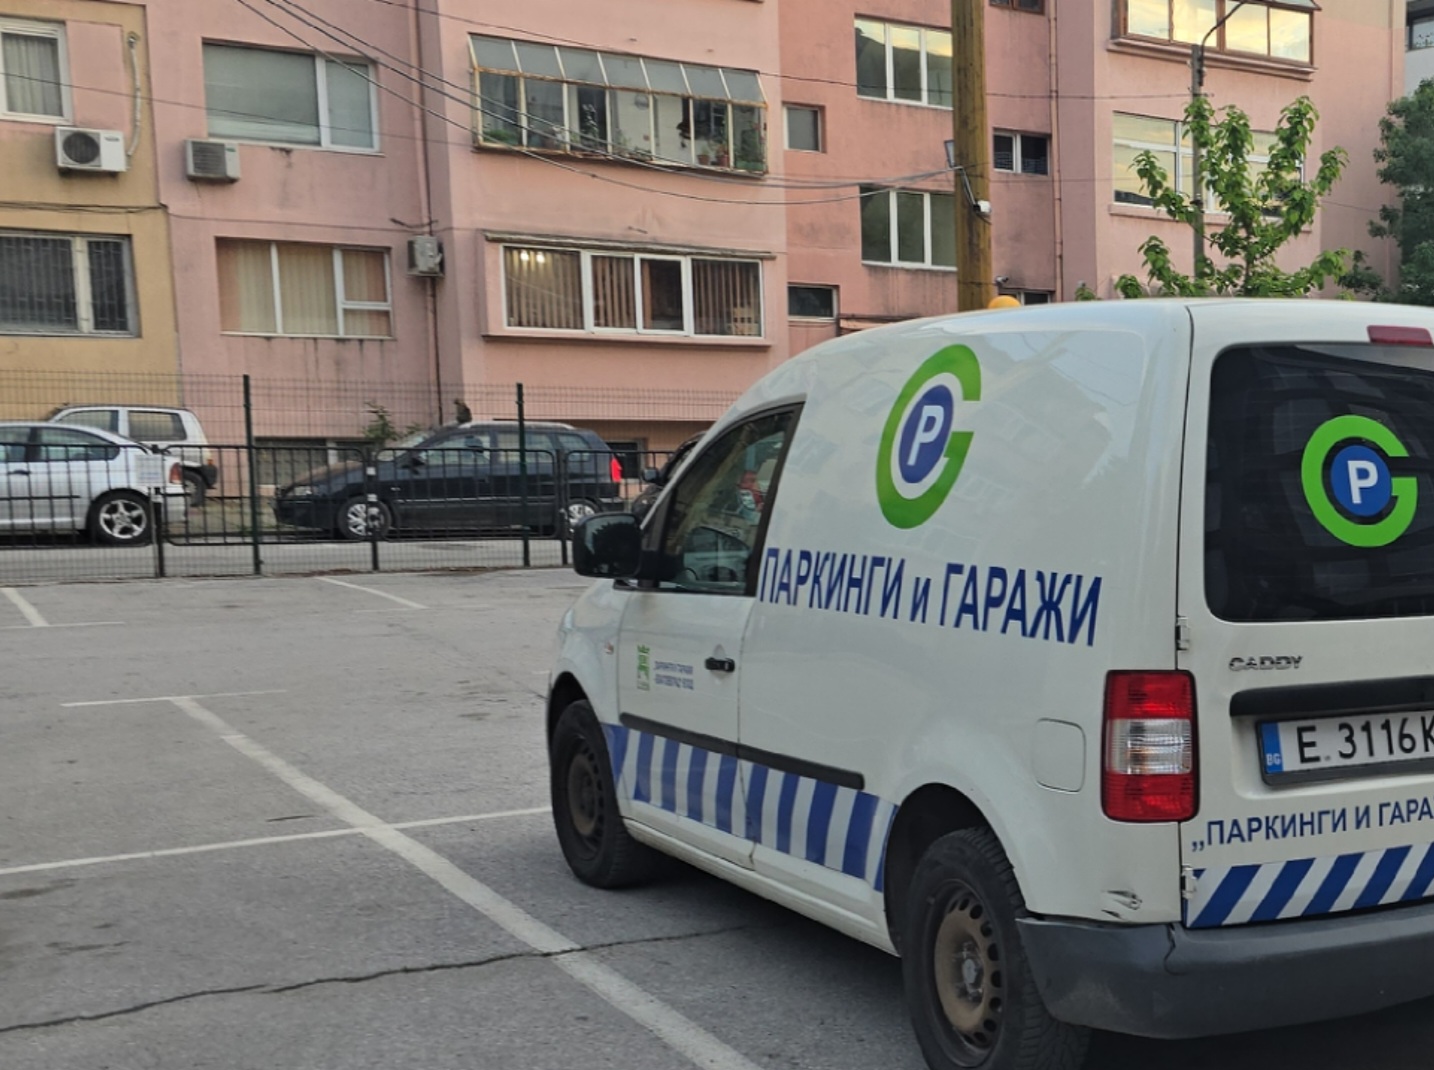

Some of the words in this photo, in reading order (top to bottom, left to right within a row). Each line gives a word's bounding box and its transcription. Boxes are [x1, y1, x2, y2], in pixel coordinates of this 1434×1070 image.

[759, 548, 905, 620] ПАРКИНГИ
[939, 562, 1102, 647] ГАРАЖИ
[1229, 655, 1303, 671] CADDY
[1266, 754, 1282, 765] BG
[1355, 805, 1370, 829] И
